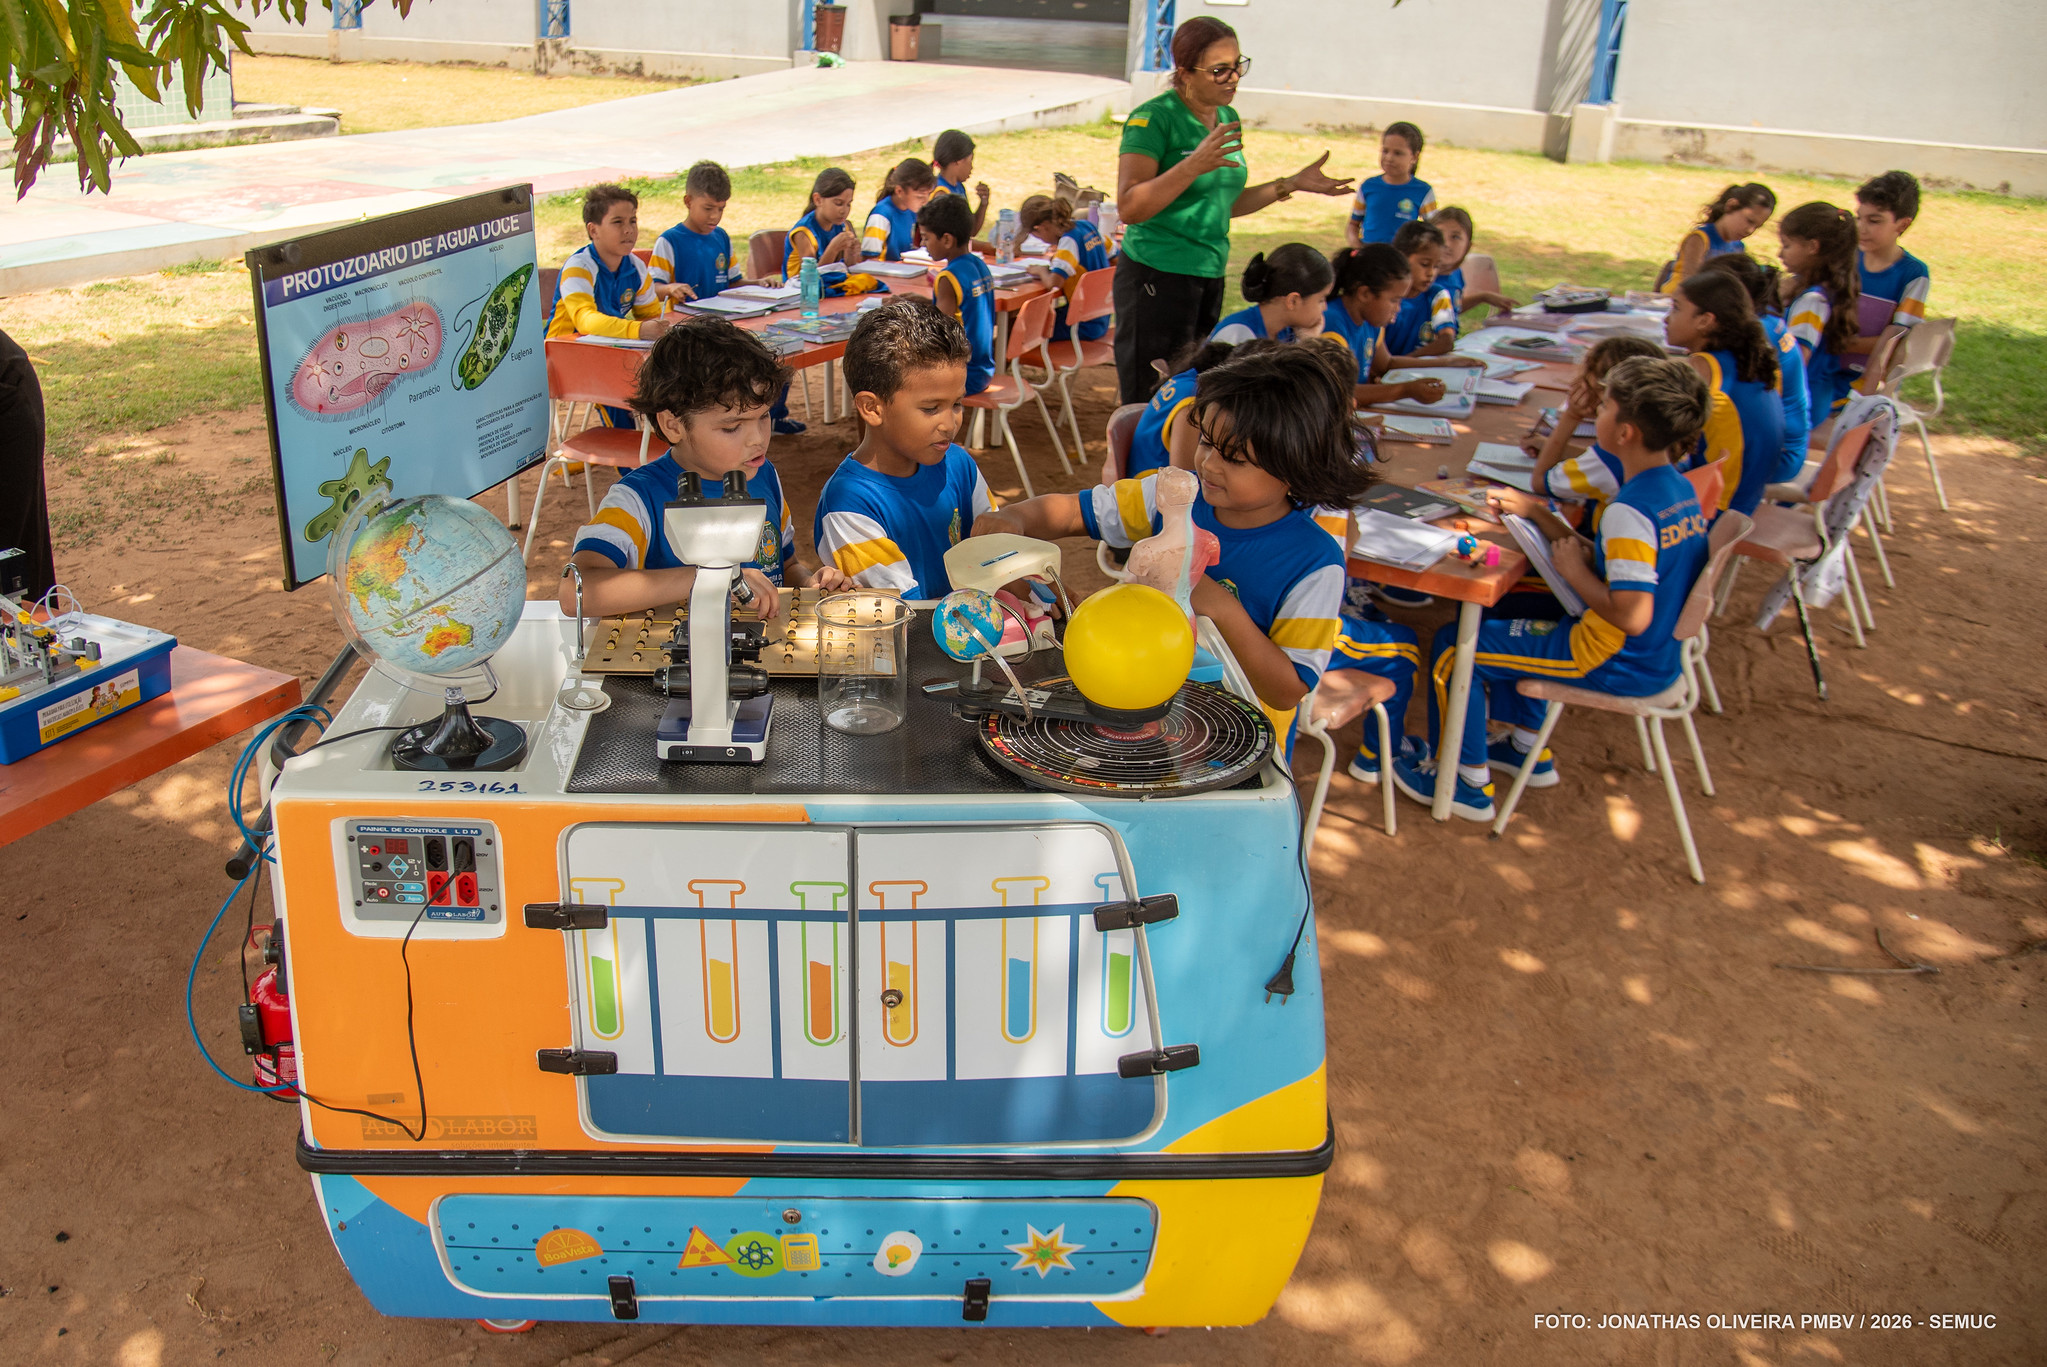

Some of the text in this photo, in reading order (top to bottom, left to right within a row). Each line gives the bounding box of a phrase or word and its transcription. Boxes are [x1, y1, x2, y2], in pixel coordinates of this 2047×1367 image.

[282, 214, 520, 297] PROTOZOARIO DE AGUA DOCE
[354, 282, 388, 296] MACRONÚCLEO
[510, 346, 532, 362] Euglena
[409, 384, 440, 404] Paramécio
[349, 418, 381, 435] MICRONÚCLEO
[333, 444, 353, 457] NÚCLEO
[418, 780, 528, 795] 253161
[364, 1118, 534, 1140] AUTOLABOR
